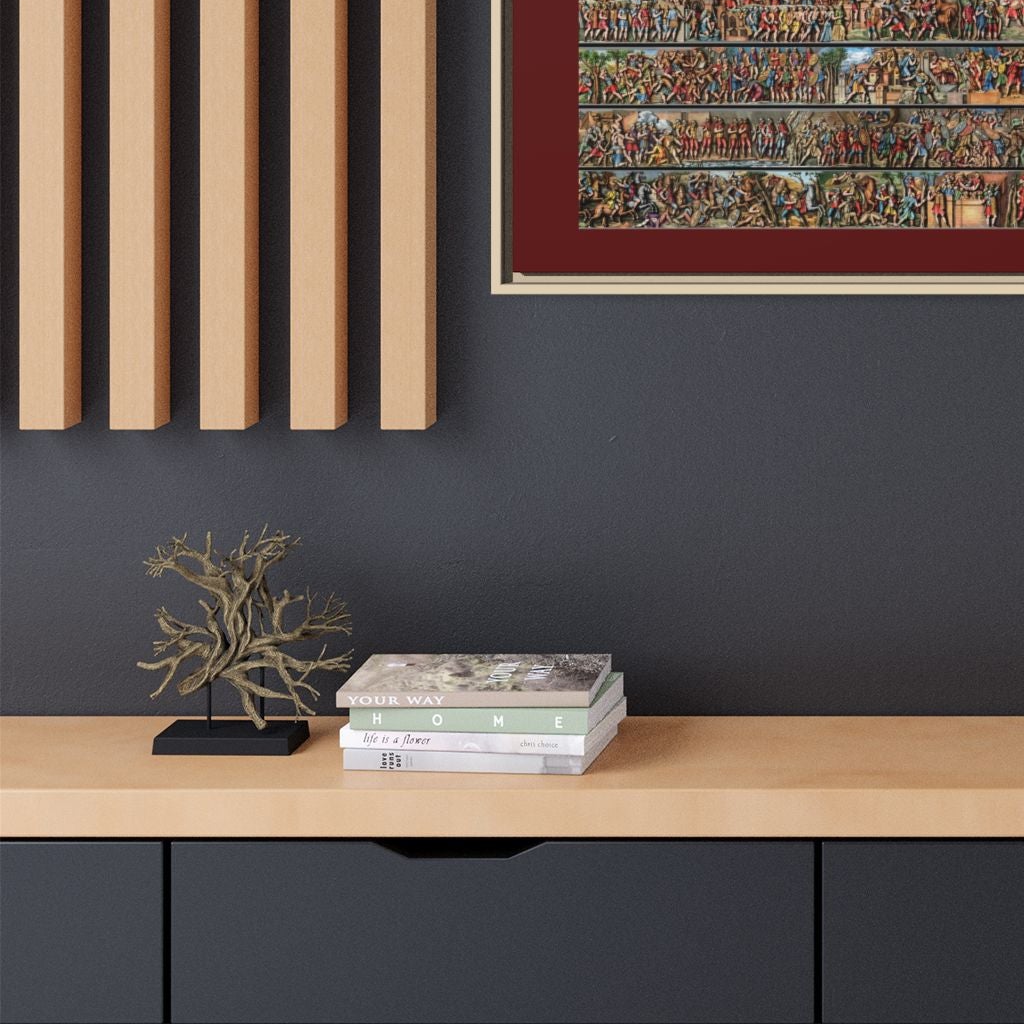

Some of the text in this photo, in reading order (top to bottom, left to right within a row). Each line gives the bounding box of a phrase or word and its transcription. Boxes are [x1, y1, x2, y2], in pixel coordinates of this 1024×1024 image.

[348, 696, 445, 705] YOUR WAY
[363, 732, 431, 748] life is a flower
